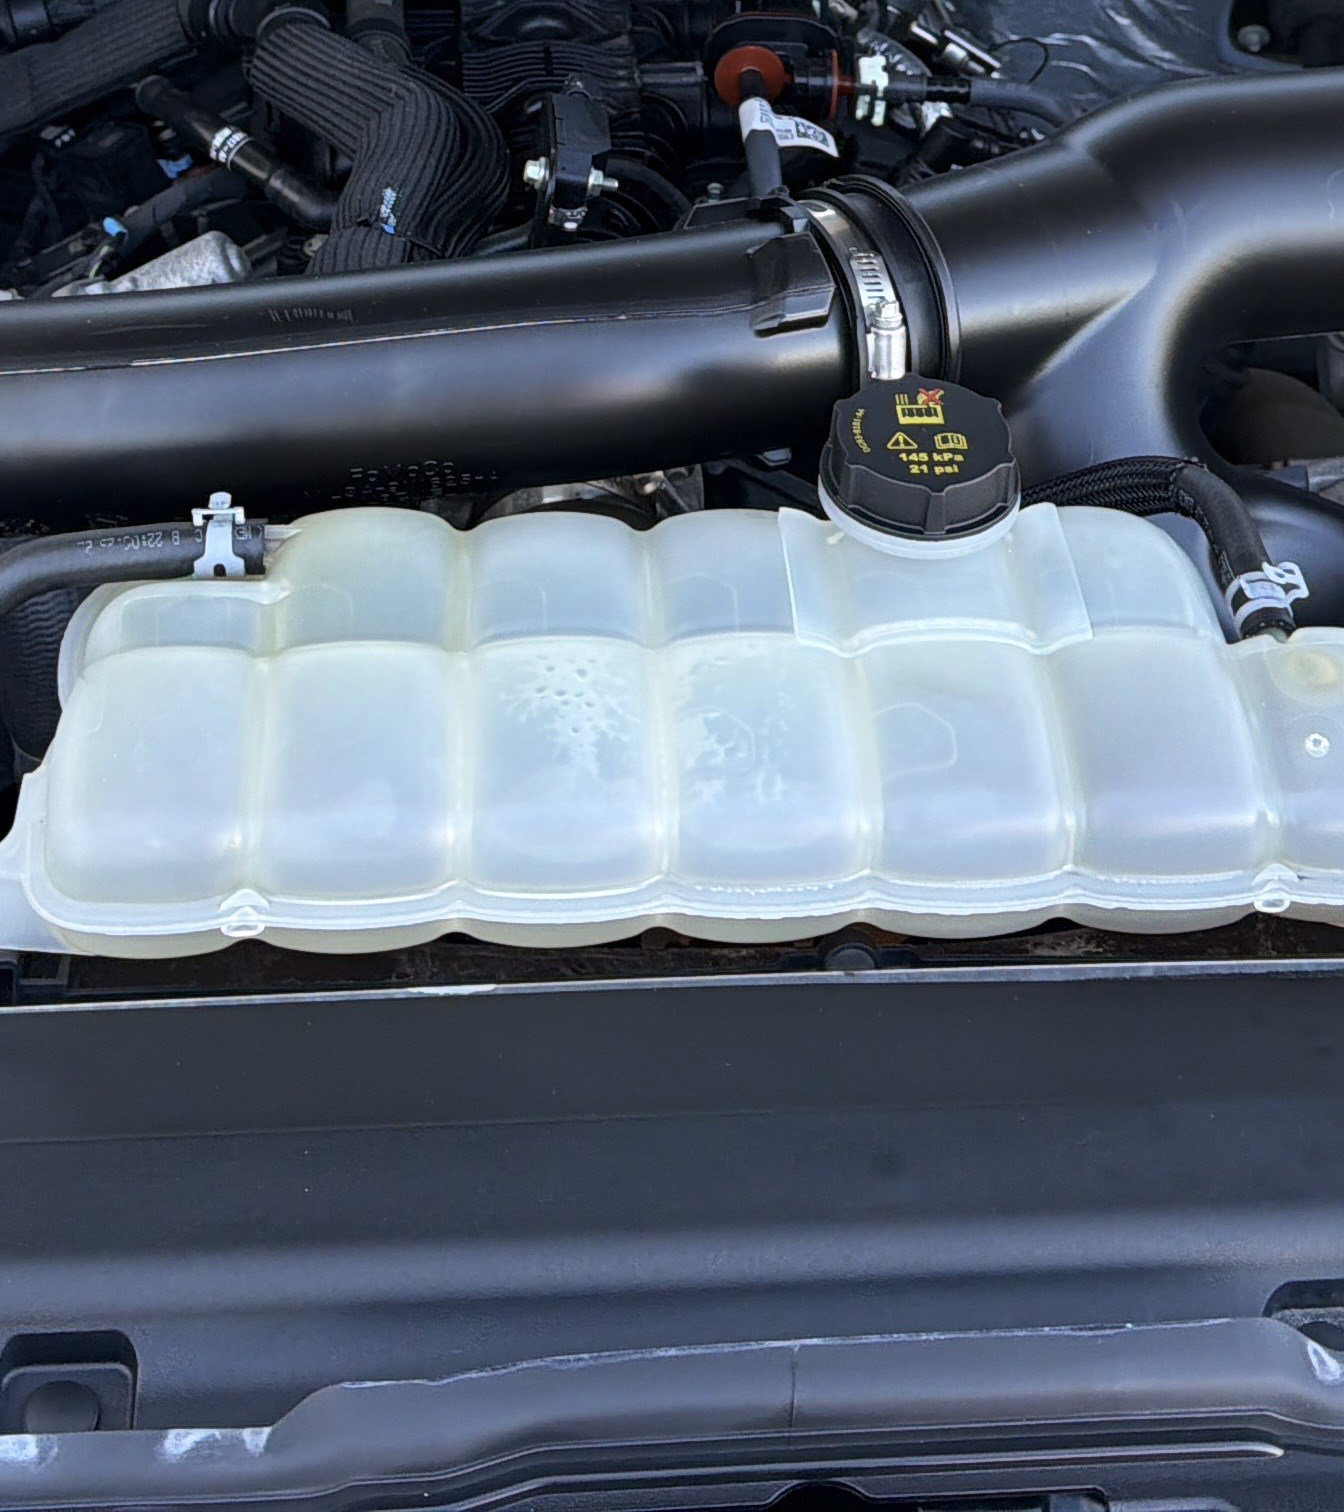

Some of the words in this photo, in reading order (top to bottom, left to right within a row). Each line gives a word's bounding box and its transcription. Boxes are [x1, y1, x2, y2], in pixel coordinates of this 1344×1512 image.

[899, 453, 929, 462] 145
[933, 453, 964, 462] kPa
[909, 465, 928, 474] 21
[934, 464, 959, 475] psi
